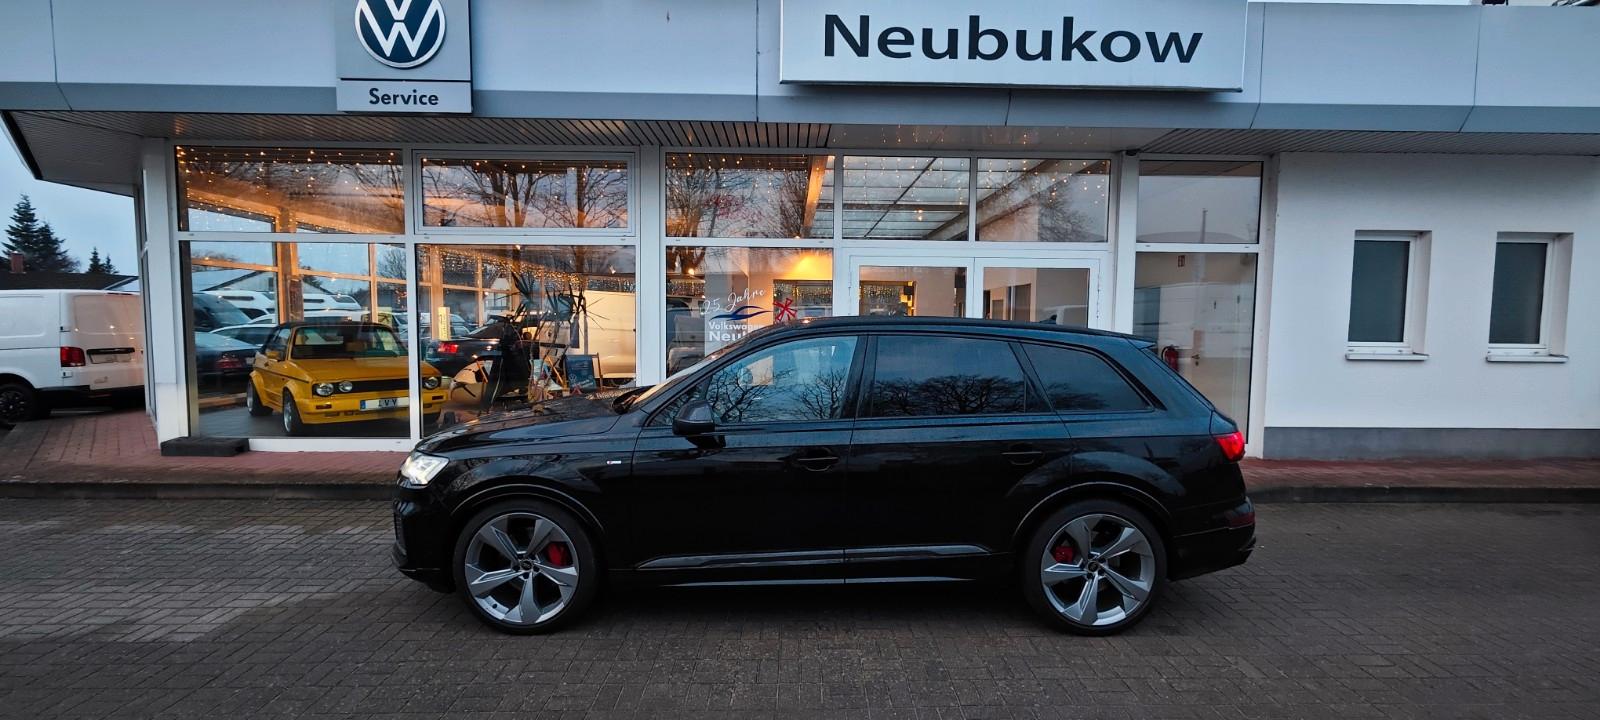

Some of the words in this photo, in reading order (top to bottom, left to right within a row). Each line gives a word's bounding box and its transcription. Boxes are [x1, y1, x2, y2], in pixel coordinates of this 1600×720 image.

[824, 14, 1203, 63] Neubukow
[369, 87, 439, 105] Service
[702, 298, 721, 315] 25
[725, 288, 765, 312] Jahre
